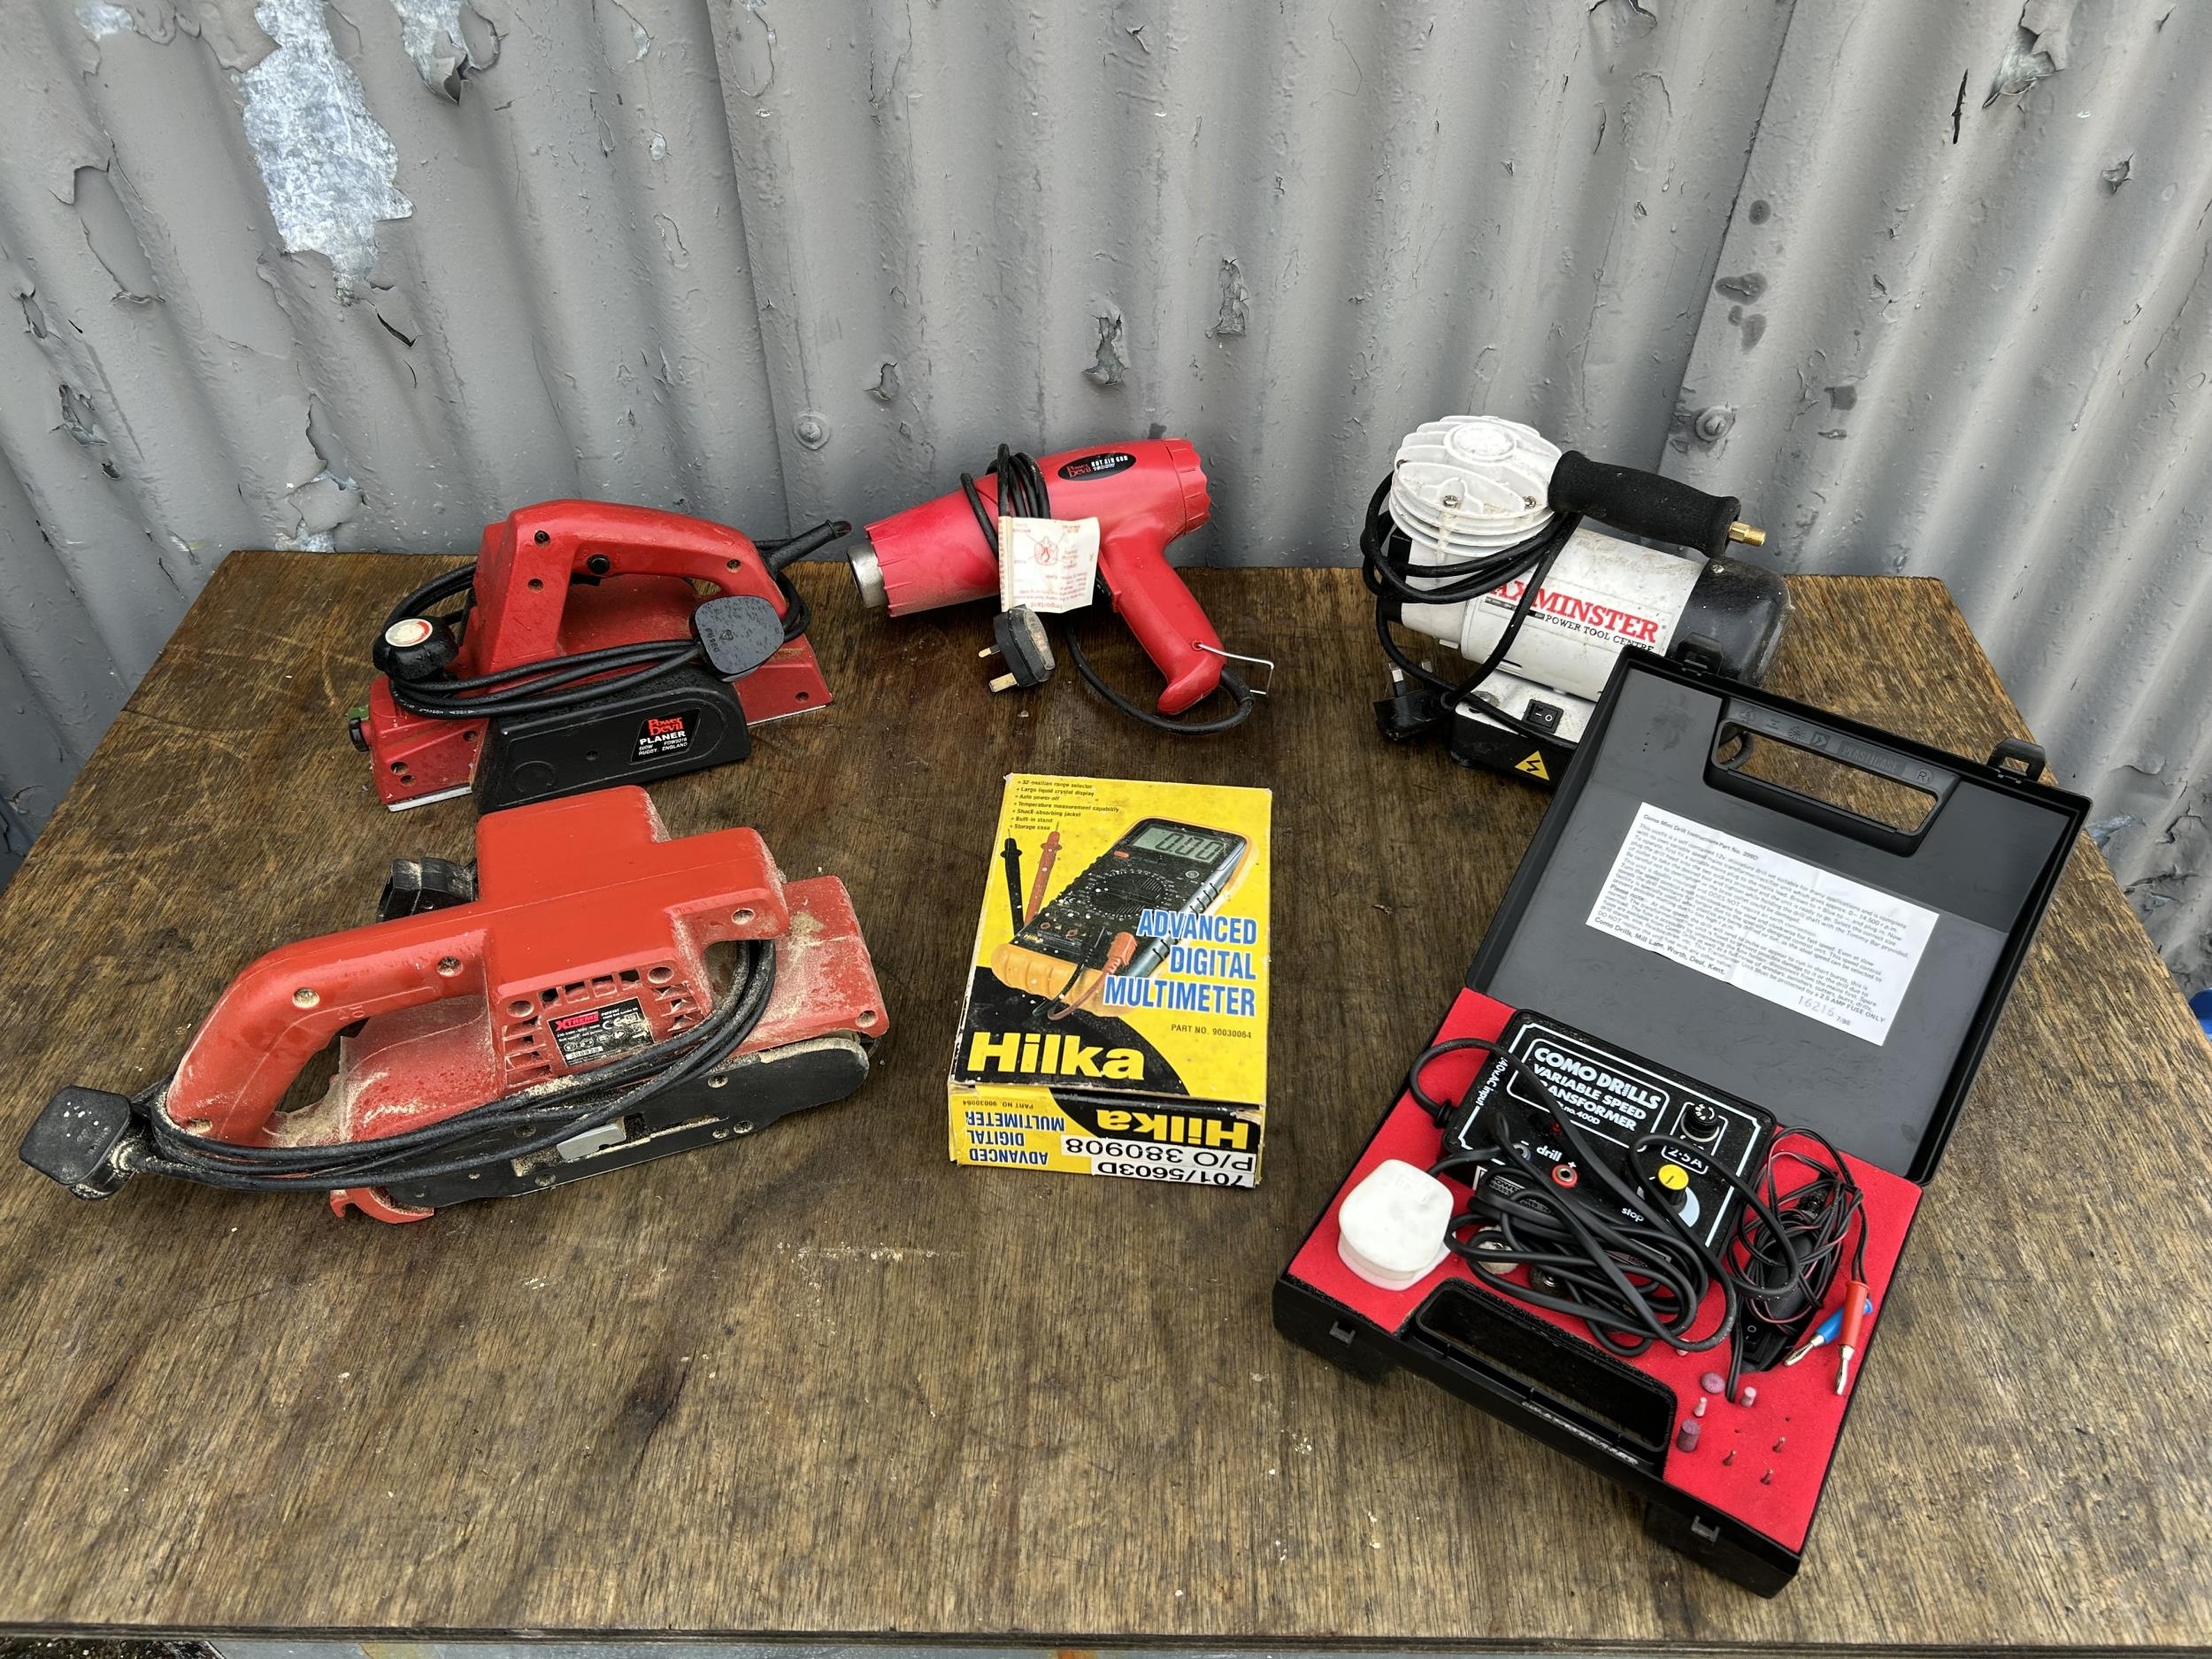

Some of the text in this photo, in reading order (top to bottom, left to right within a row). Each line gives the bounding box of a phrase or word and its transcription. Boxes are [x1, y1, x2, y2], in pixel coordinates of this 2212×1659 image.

[1544, 614, 1581, 632] POWER
[1583, 626, 1610, 641] TOOL
[648, 717, 682, 727] Power
[649, 721, 684, 736] Devil
[639, 730, 687, 745] PLANER
[662, 742, 687, 751] ENGLAND
[1643, 813, 1660, 823] Como
[1137, 910, 1256, 944] ADVANCED
[1594, 916, 1614, 928] Como
[1170, 946, 1256, 980] DIGITAL
[1104, 977, 1256, 1017] MULTIMETER
[556, 1011, 599, 1030] XTREME
[1171, 1024, 1252, 1039] PART NO. 90030064
[966, 1032, 1145, 1081] Hilka
[1534, 1048, 1661, 1110] COMO DRILLS
[1533, 1064, 1647, 1120] VARIABLE SPEED
[1539, 1079, 1636, 1132] ANSFORMER
[965, 1110, 1064, 1133] MULTIMETER
[1096, 1110, 1249, 1150] Hilka
[970, 1130, 1025, 1147] DIGITAL
[970, 1148, 1048, 1165] ADVANCED
[1065, 1138, 1254, 1172] P/O 380908
[1536, 1145, 1563, 1162] drill
[1097, 1162, 1245, 1187] 701/5603D
[1621, 1207, 1644, 1223] stop
